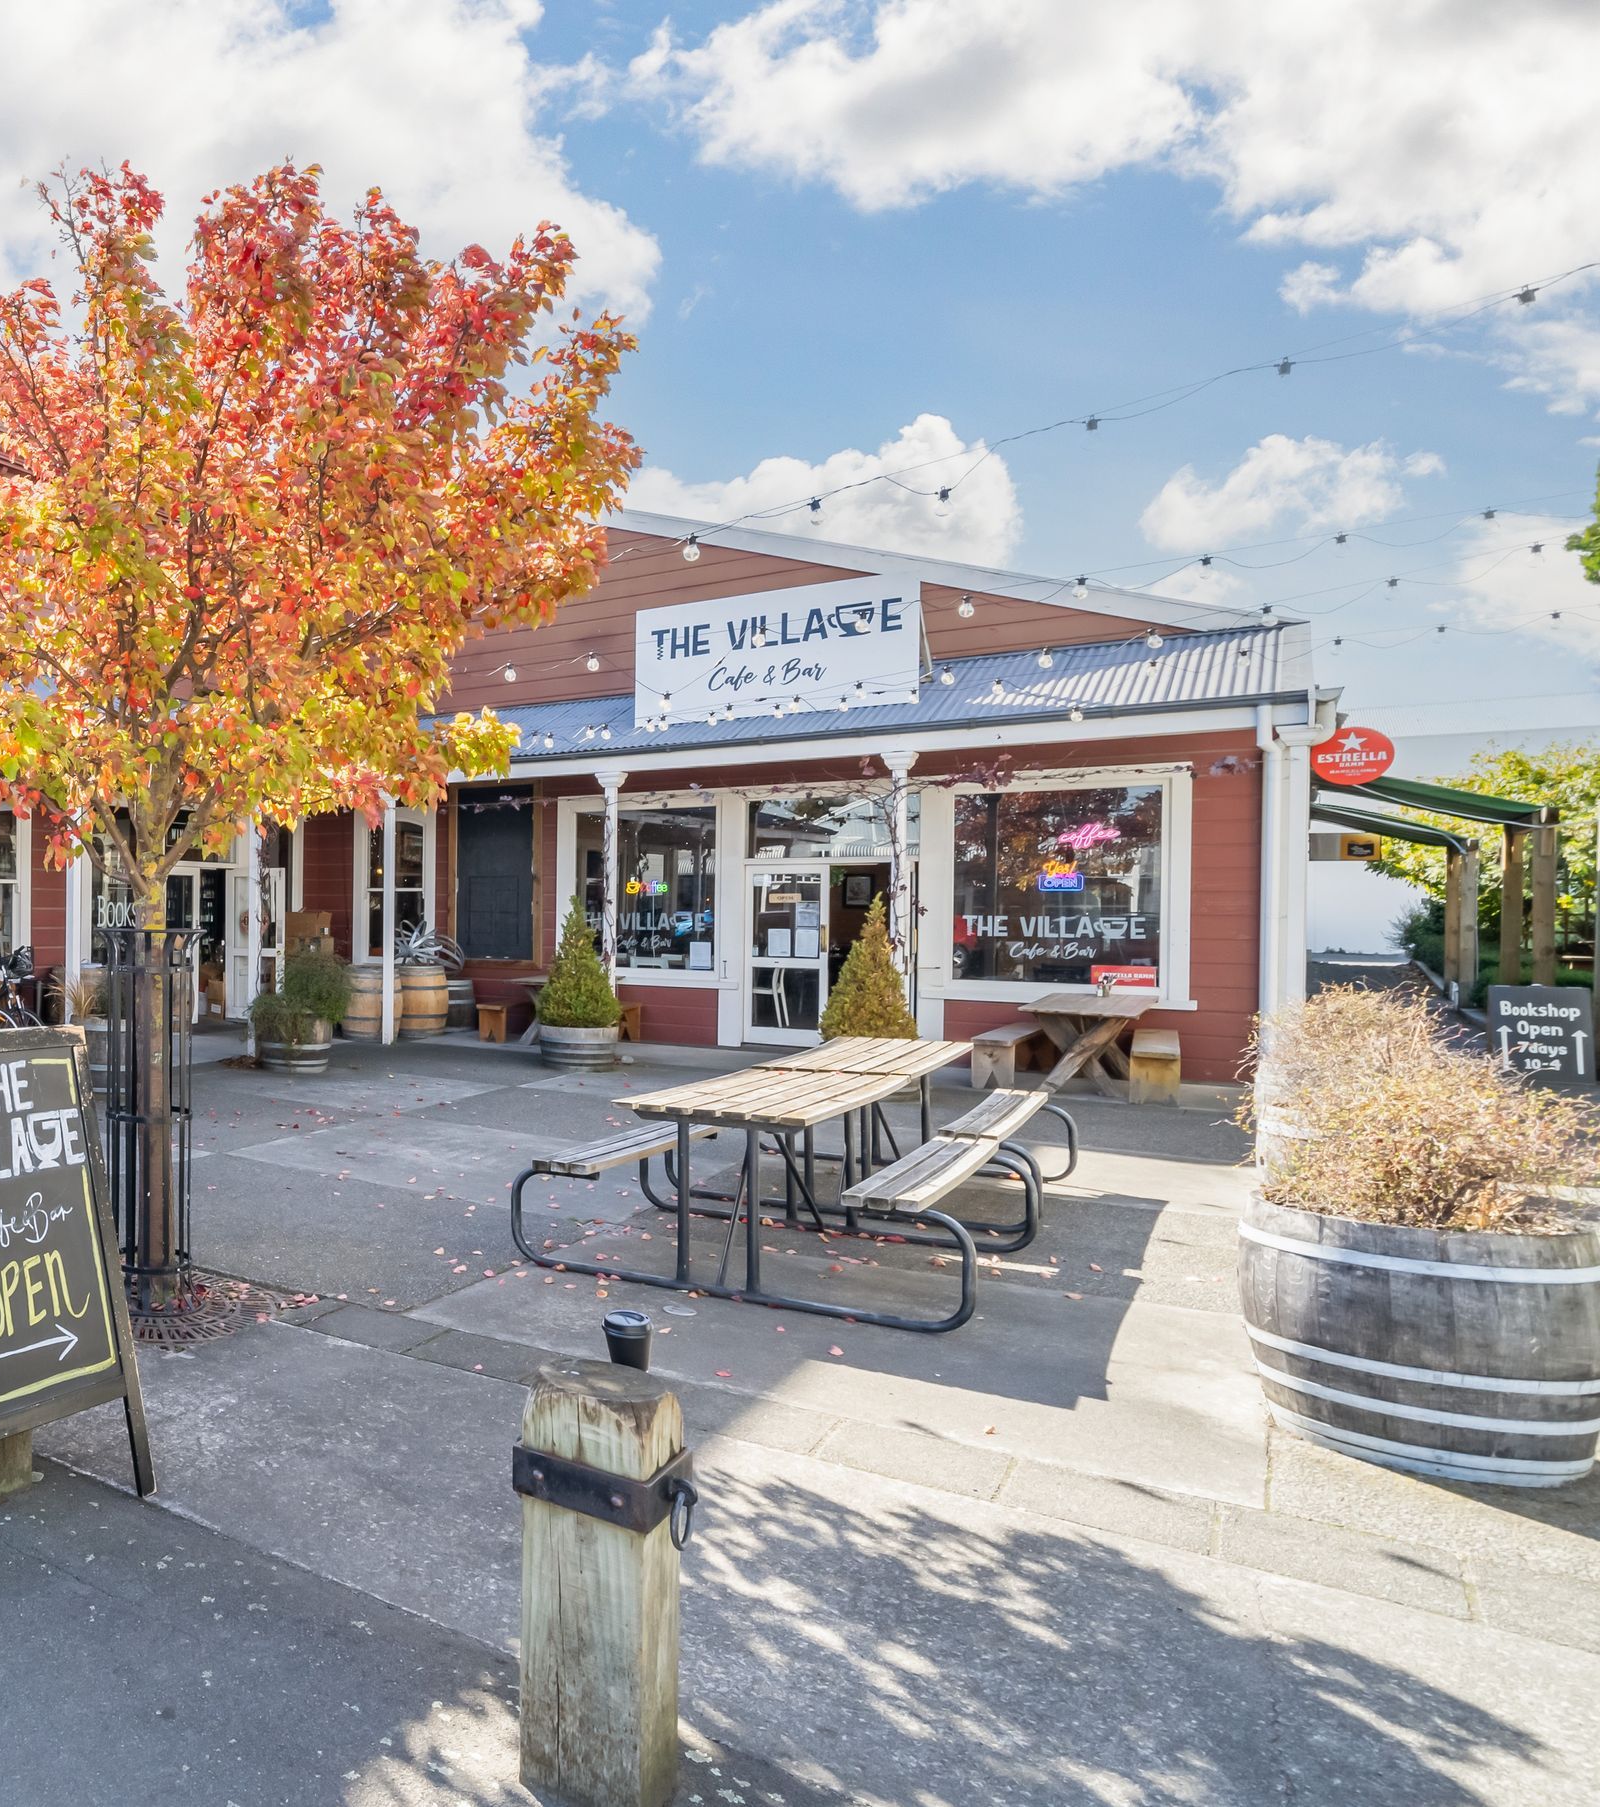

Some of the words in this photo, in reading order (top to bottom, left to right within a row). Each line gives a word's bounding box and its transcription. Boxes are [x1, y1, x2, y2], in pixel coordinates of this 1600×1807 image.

[651, 622, 710, 661] THE
[727, 597, 903, 650] VILLAGE
[708, 666, 758, 692] Cafe
[763, 666, 777, 685] &
[782, 658, 828, 686] Bar
[1317, 751, 1388, 764] ESTRELLA
[1059, 823, 1121, 849] coffee
[1043, 878, 1078, 889] OPEN
[962, 914, 1008, 938] THE
[1020, 914, 1147, 940] VILLAGE
[1009, 942, 1046, 960] Cafe
[1050, 944, 1061, 958] &
[1062, 942, 1097, 960] Bar
[1499, 1000, 1581, 1021] Bookshop
[1516, 1020, 1564, 1040] Open
[1524, 1058, 1562, 1071] 10-4
[25, 1191, 73, 1244] Bar
